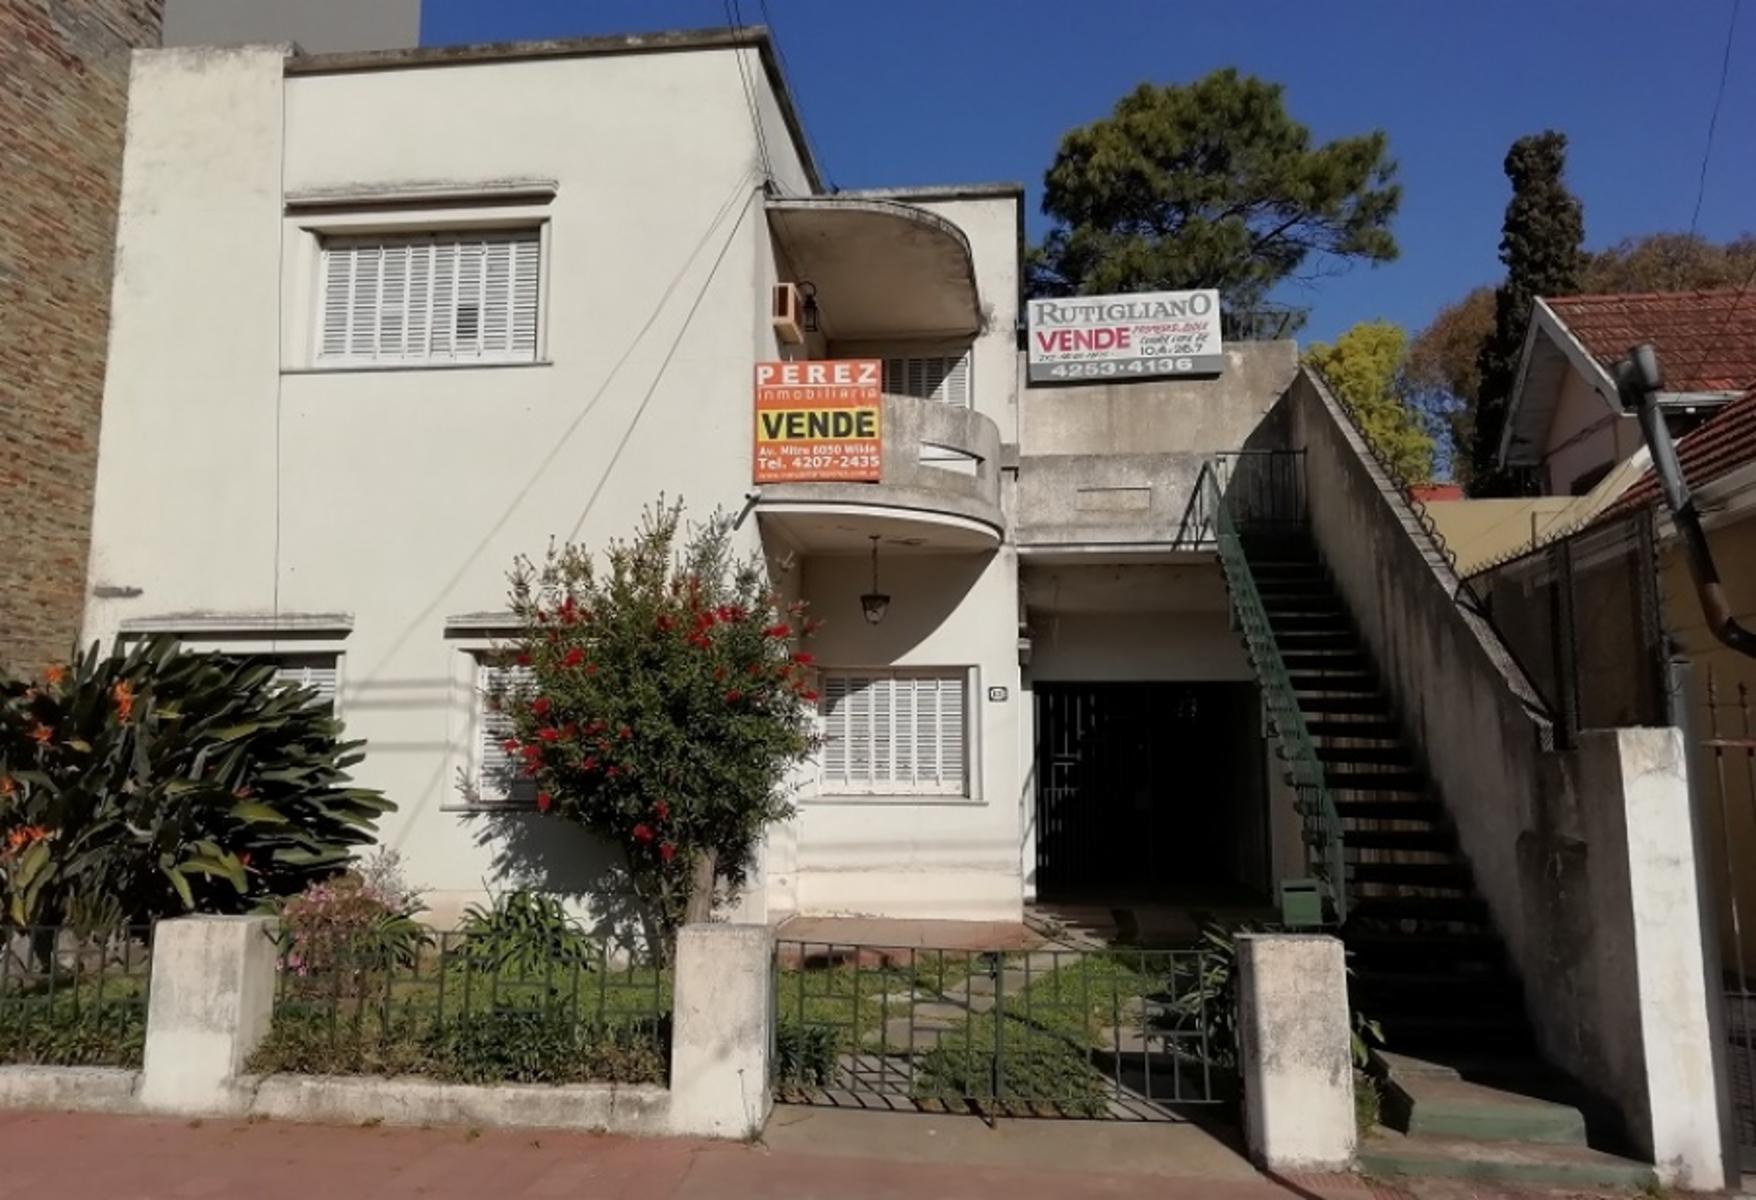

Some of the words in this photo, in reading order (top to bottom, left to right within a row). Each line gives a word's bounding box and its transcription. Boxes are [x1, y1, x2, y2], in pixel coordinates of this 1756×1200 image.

[1035, 293, 1211, 326] RUTIGLIANO
[1037, 327, 1131, 353] VENDE
[757, 363, 877, 385] PEREZ
[761, 410, 876, 440] VENDE
[757, 457, 787, 470] Tel.
[792, 455, 880, 468] 4207-2435
